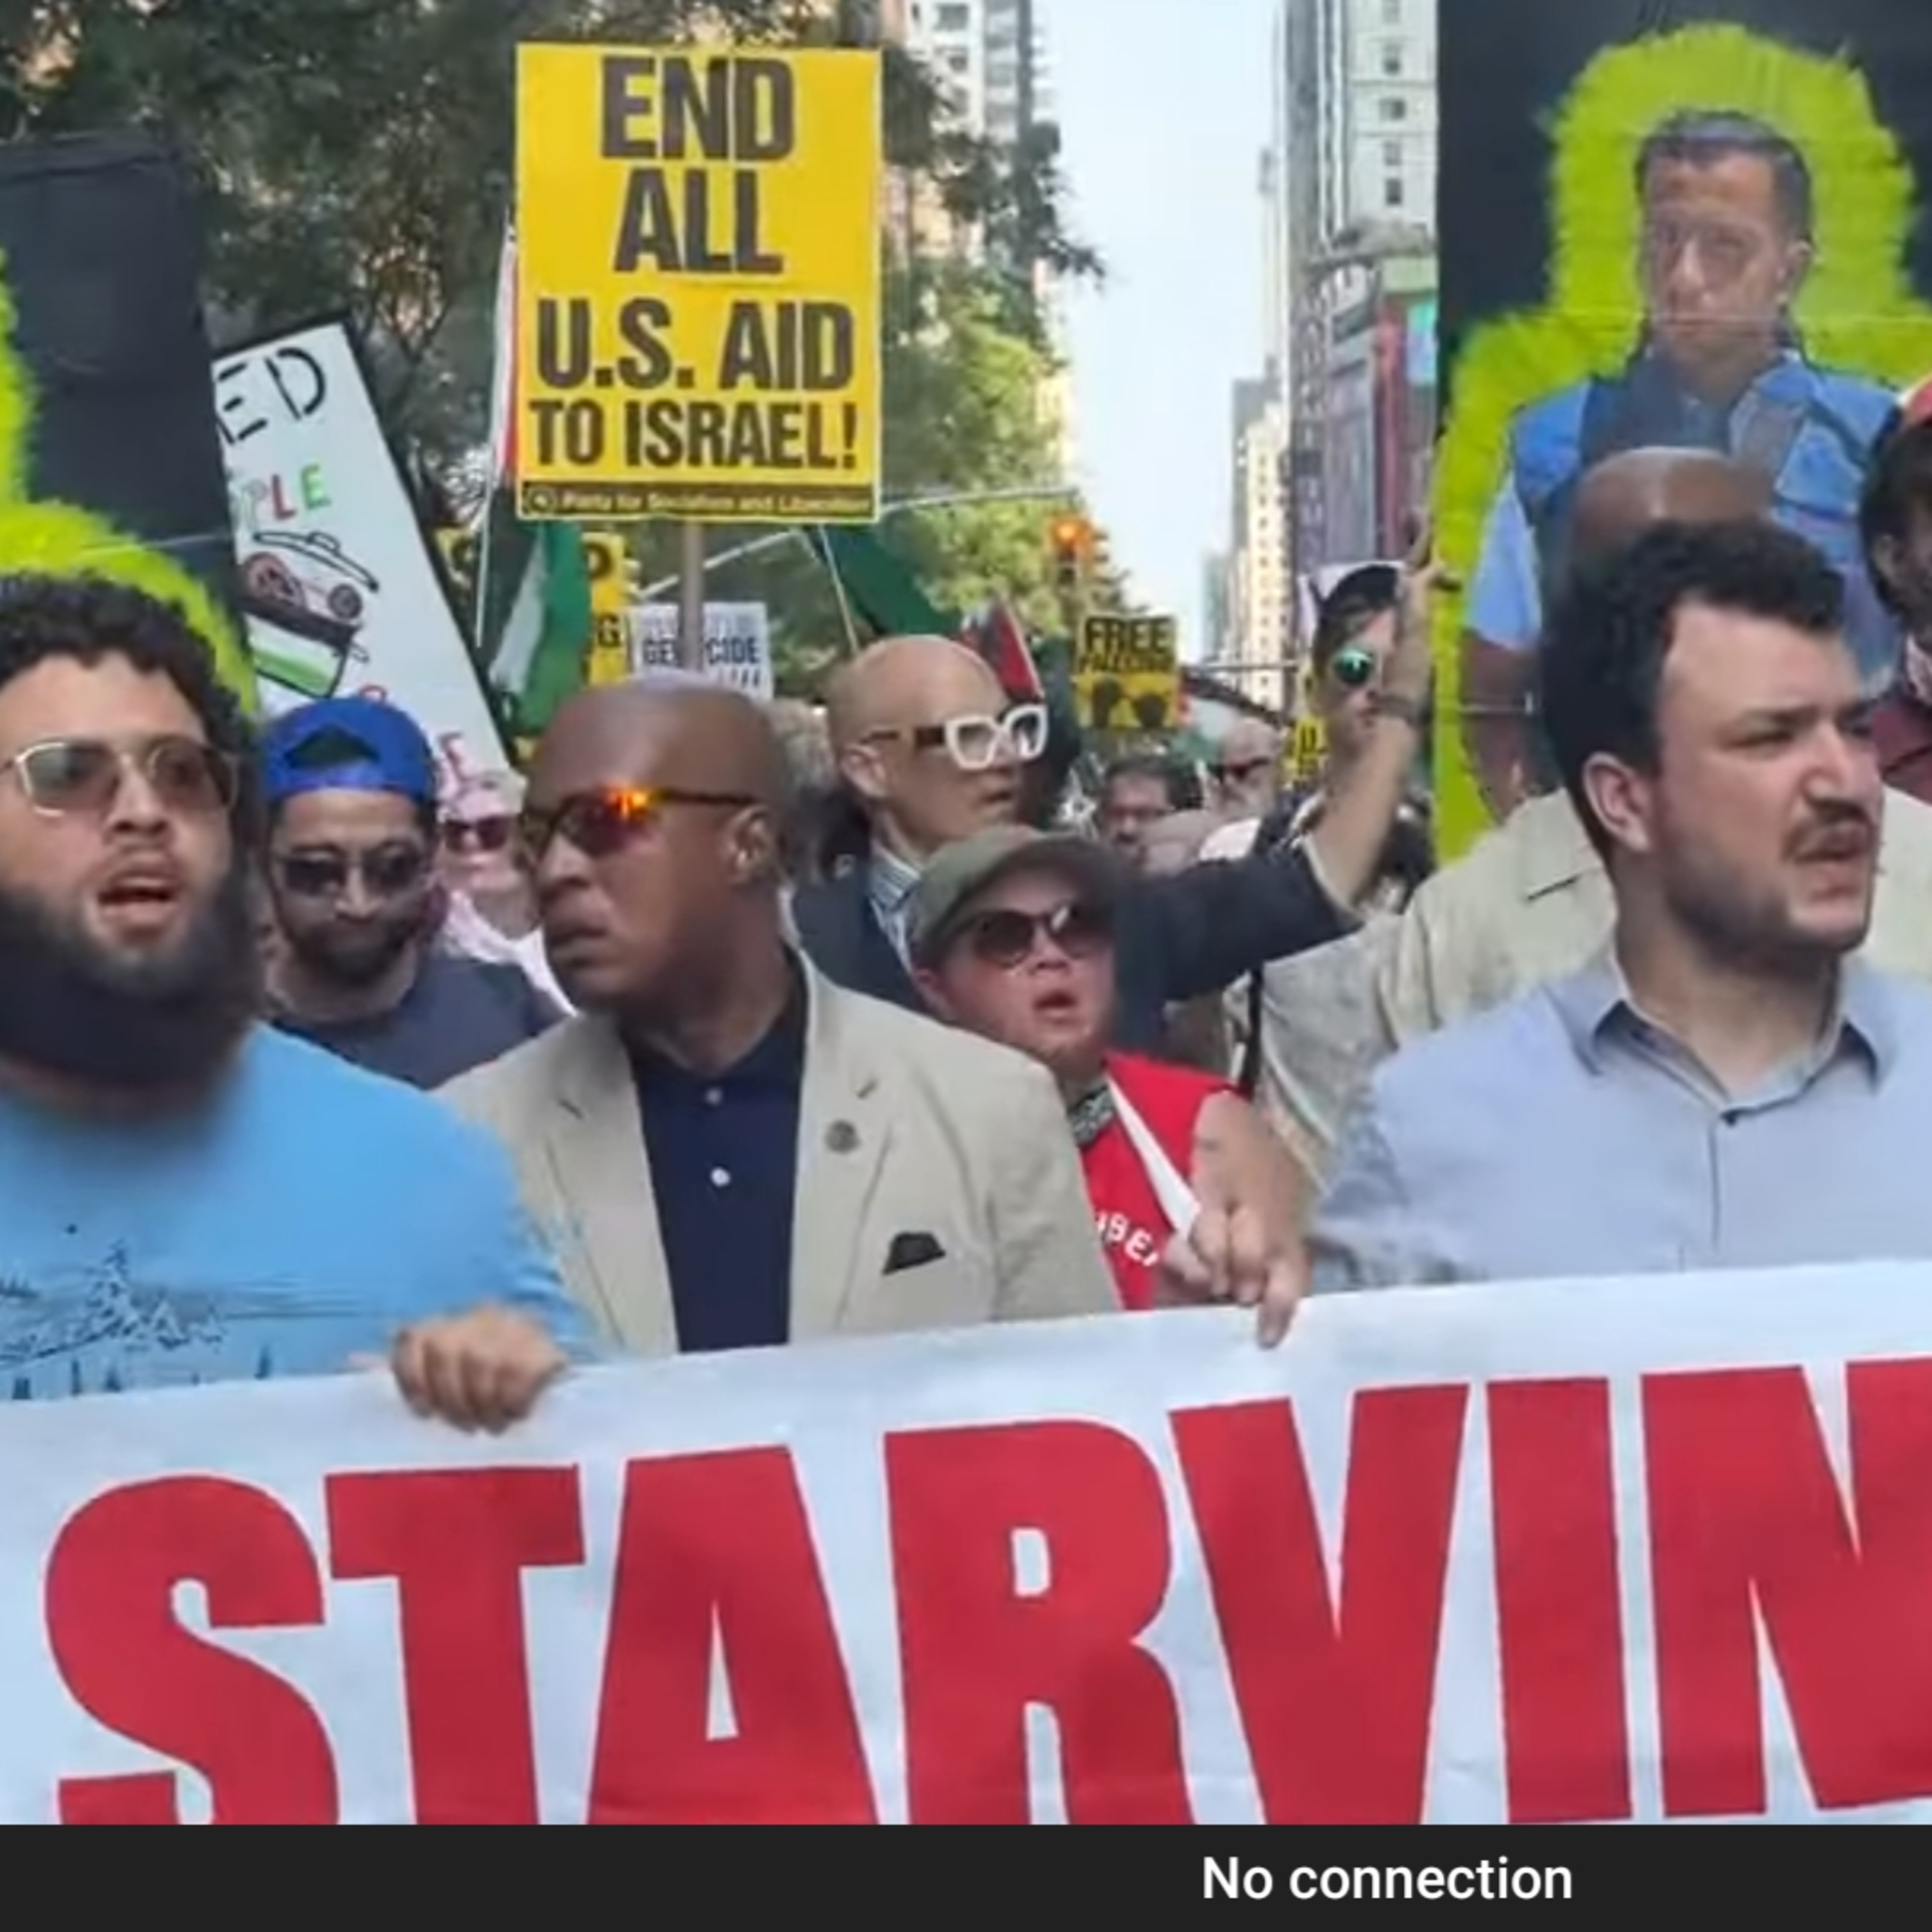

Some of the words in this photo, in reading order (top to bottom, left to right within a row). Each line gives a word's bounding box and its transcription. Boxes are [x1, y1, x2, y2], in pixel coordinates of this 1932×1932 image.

[601, 57, 795, 160] END
[612, 167, 784, 274] ALL
[537, 297, 695, 390] U.S.
[718, 301, 853, 390] AID
[529, 399, 604, 466] TO
[625, 399, 857, 469] ISRAEL!
[1084, 617, 1171, 654] FREE
